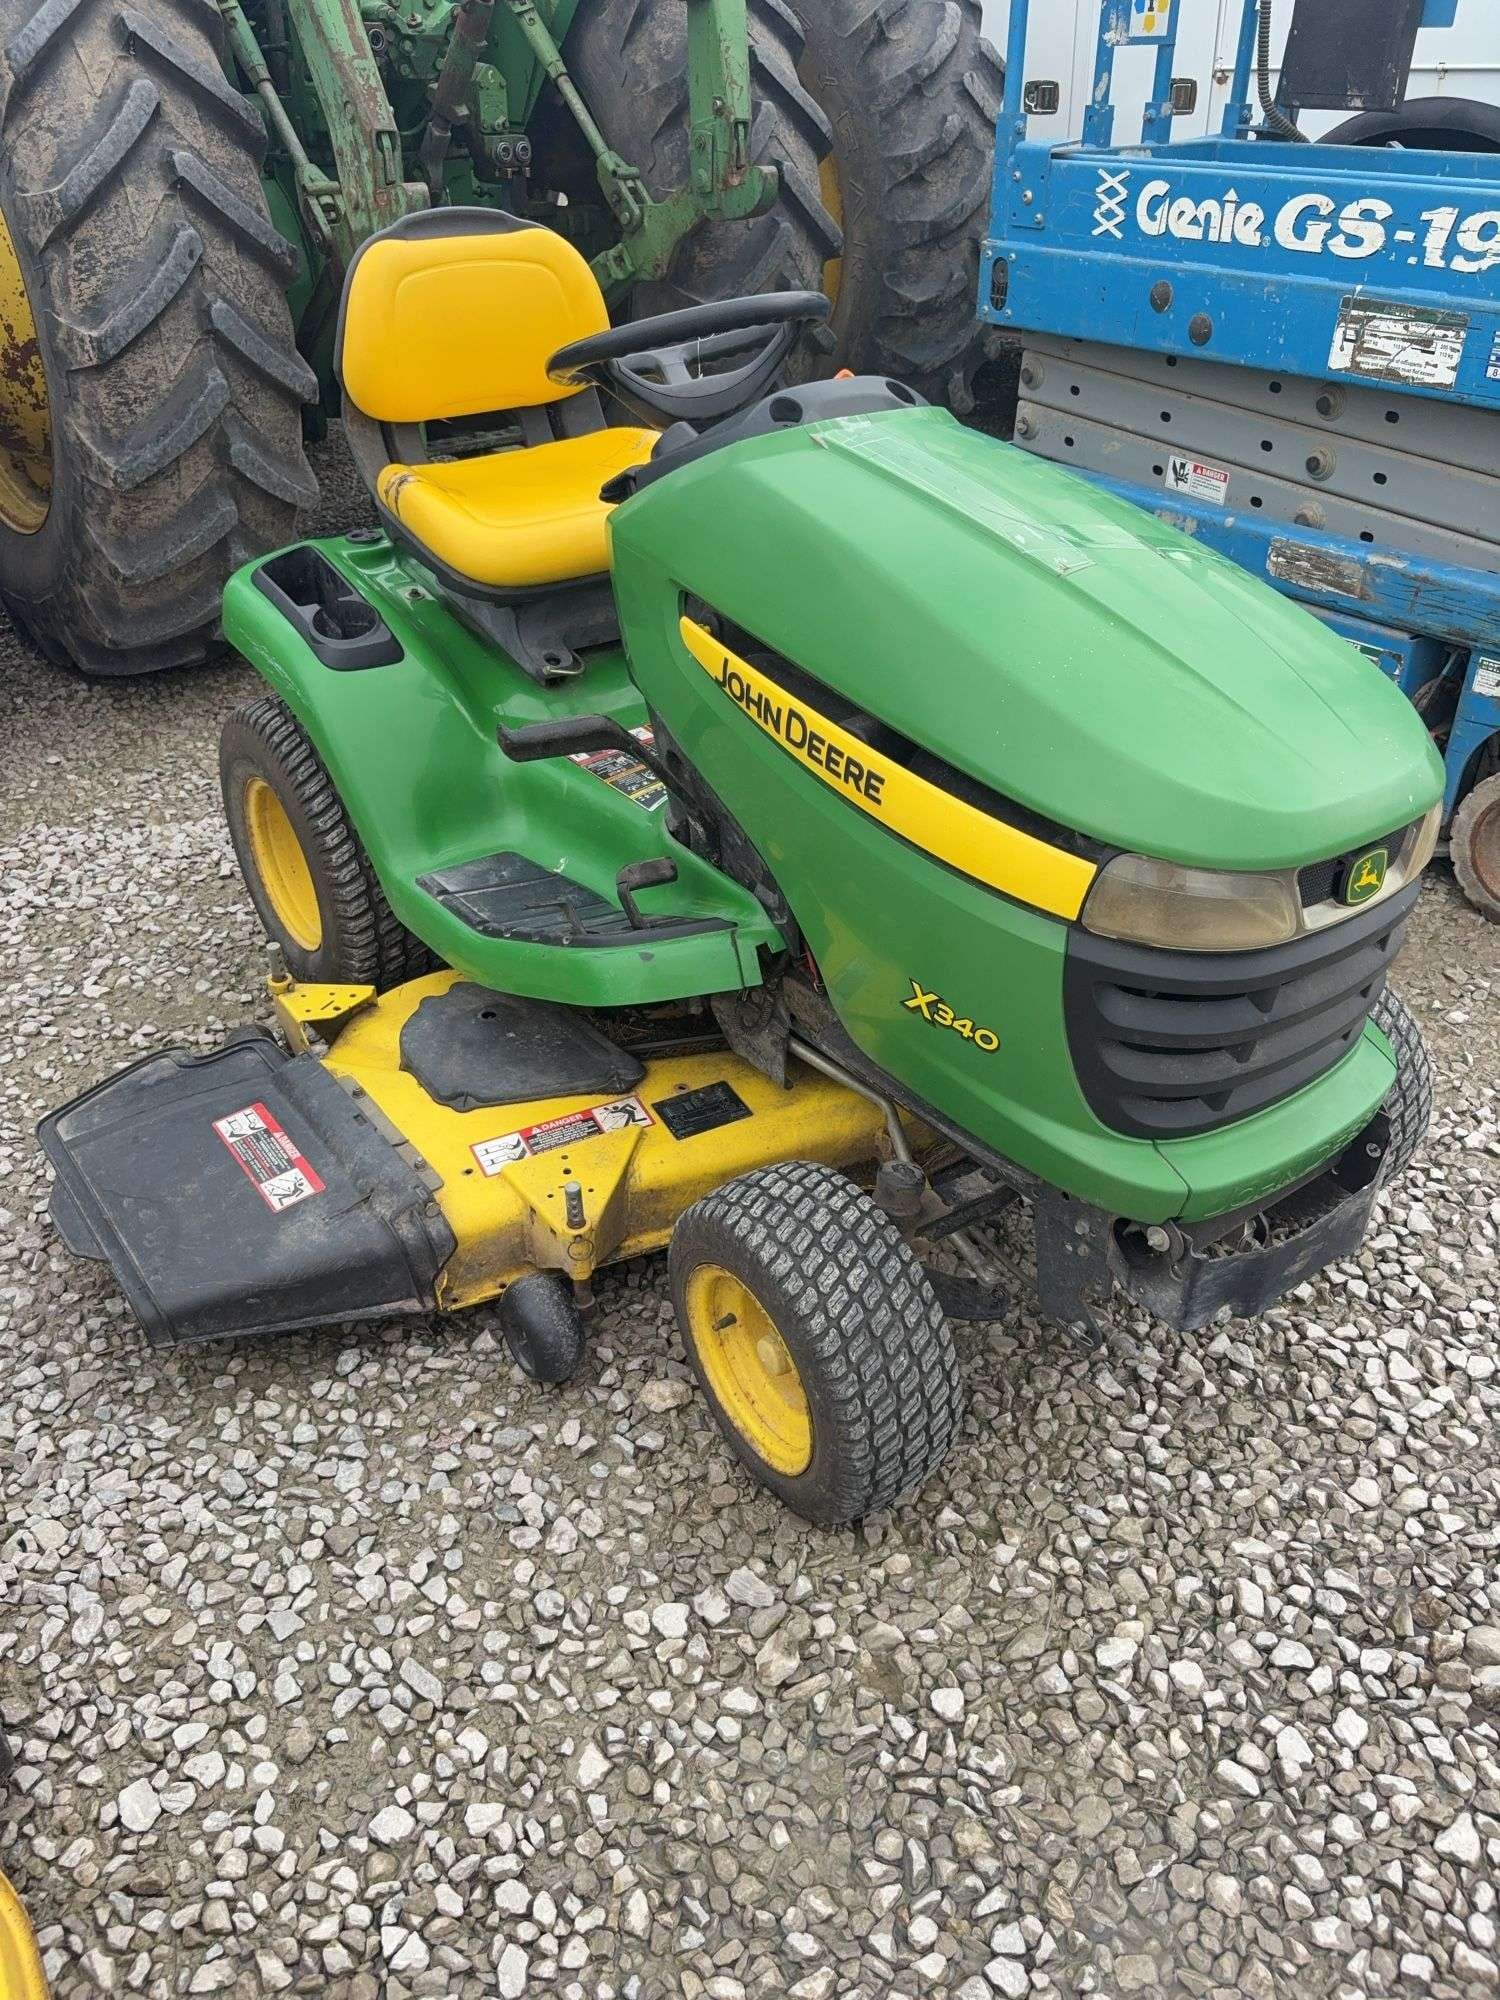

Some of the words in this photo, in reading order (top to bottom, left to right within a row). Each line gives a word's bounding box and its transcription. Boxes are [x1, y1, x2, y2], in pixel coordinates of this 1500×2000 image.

[1136, 179, 1265, 247] Genie
[1202, 465, 1225, 482] DANGER
[715, 656, 783, 735] JOHN
[785, 707, 886, 807] DEERE
[900, 977, 1001, 1053] X340
[541, 1113, 584, 1131] DANGER
